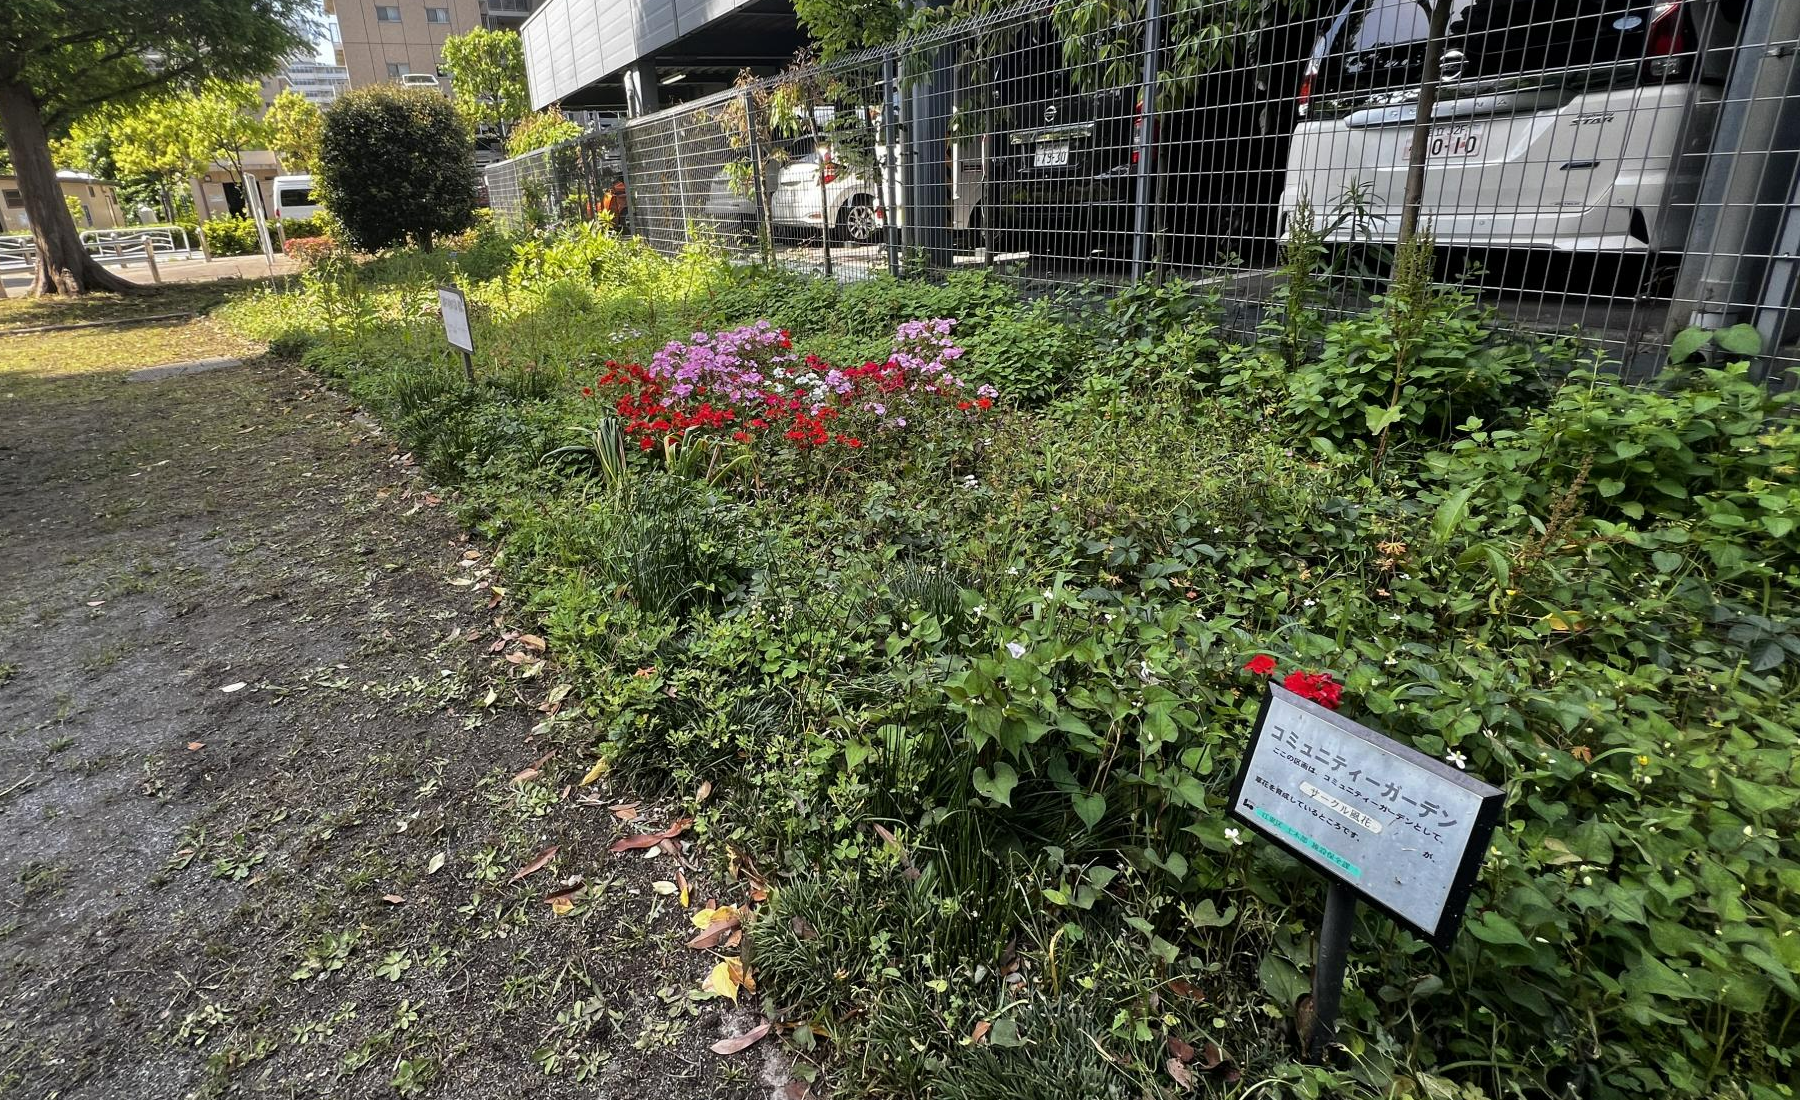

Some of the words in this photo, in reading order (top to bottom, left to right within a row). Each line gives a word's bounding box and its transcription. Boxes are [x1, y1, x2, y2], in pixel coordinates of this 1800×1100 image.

[1569, 116, 1615, 126] STAR
[1271, 725, 1458, 829] コミュニティーガーデン
[1309, 786, 1374, 829] サークル風花
